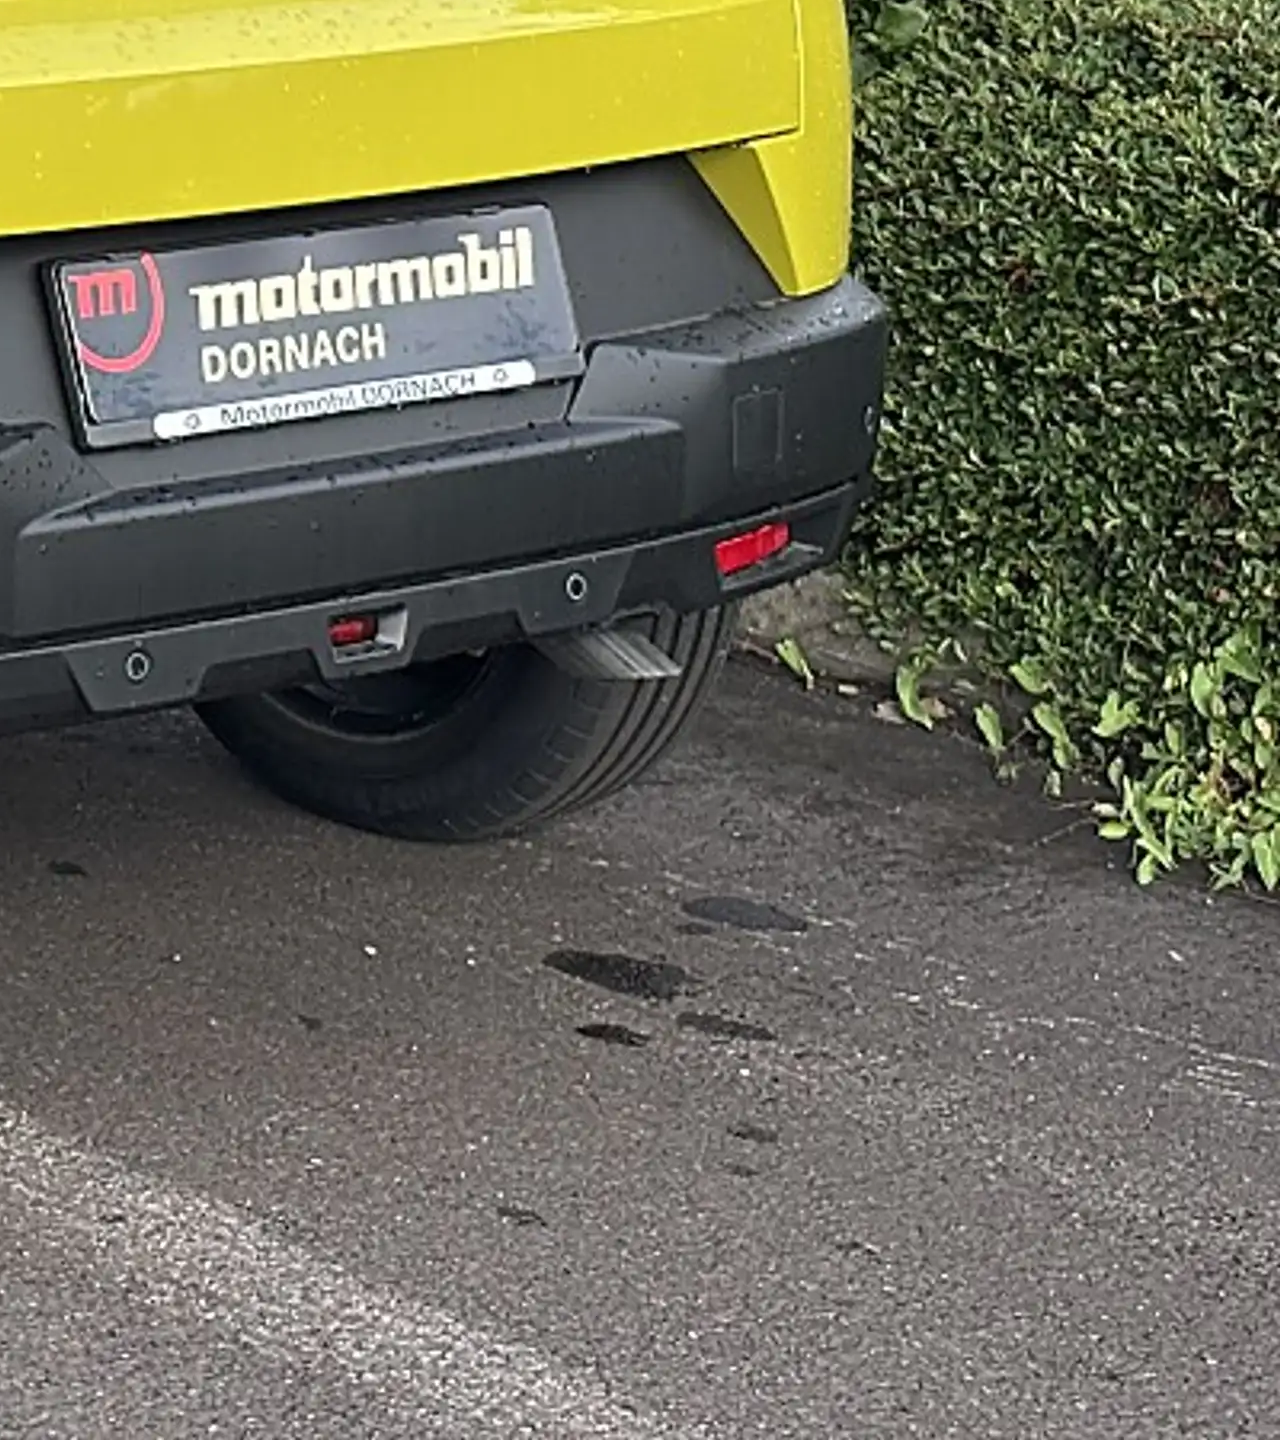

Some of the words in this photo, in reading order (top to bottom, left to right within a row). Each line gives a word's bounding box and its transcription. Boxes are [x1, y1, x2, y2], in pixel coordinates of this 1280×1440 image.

[189, 227, 535, 331] motormobil
[201, 322, 387, 384] DORNACH
[220, 389, 357, 427] Motormobil
[361, 372, 476, 406] DORNACH
